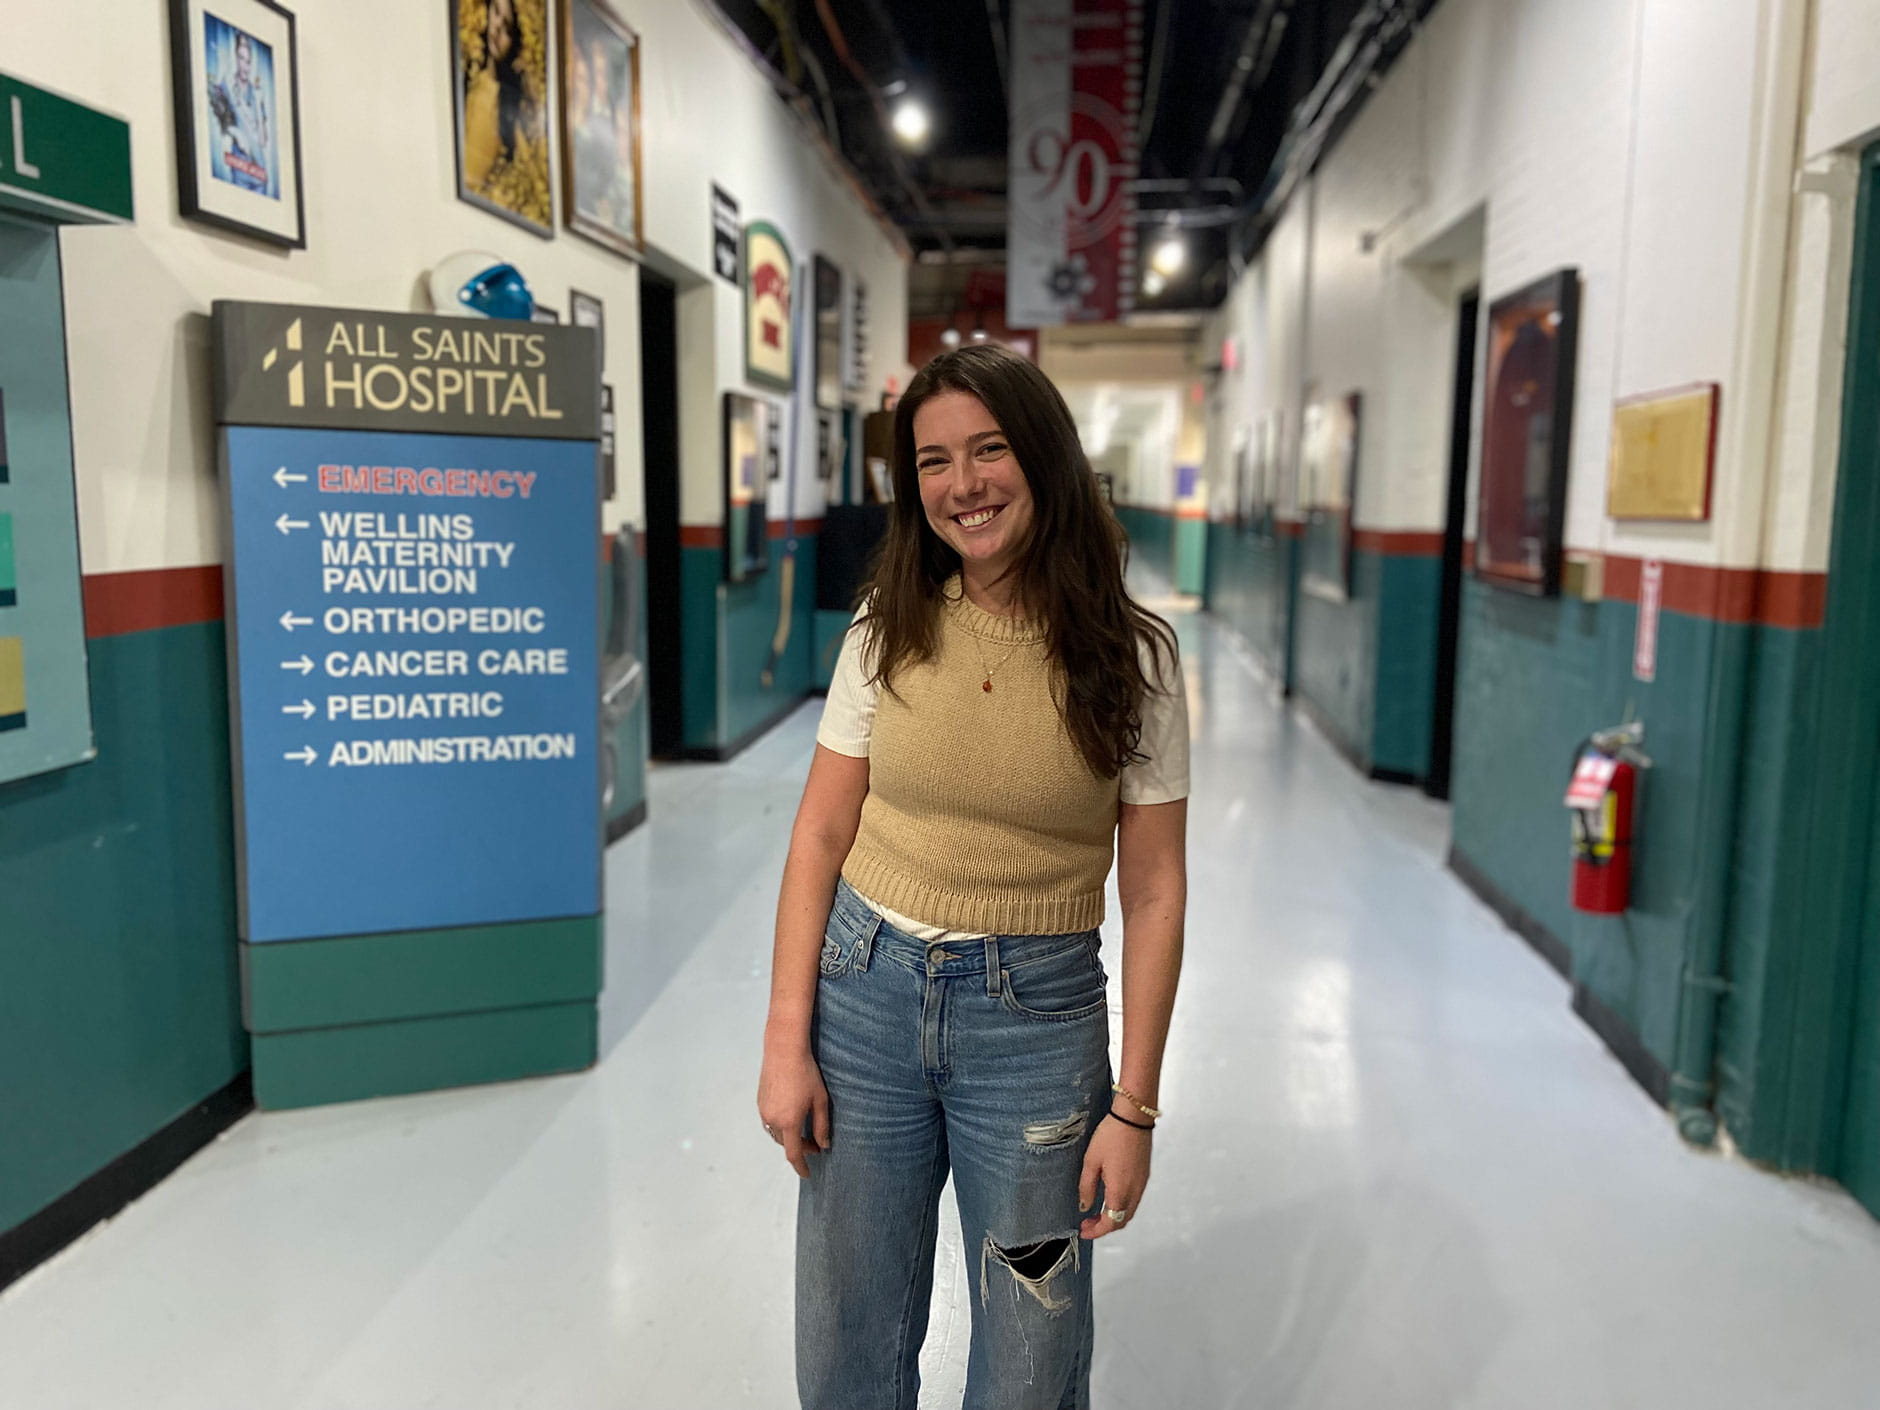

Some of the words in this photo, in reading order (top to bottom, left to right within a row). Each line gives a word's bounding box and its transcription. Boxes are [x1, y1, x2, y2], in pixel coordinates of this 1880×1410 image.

[0, 95, 41, 179] L
[1028, 124, 1110, 218] 90
[326, 323, 397, 356] ALL
[412, 328, 544, 366] SAINTS
[325, 362, 561, 417] HOSPITAL
[318, 466, 535, 497] EMERGENCY
[320, 512, 473, 539] WELLINS
[322, 540, 513, 566] MATERNITY
[323, 568, 476, 593] PAVILION
[324, 608, 544, 632] ORTHOPEDIC
[325, 651, 467, 676] CANCER
[478, 649, 567, 674] CARE
[327, 692, 502, 719] PEDIATRIC
[328, 733, 575, 765] ADMINISTRATION
